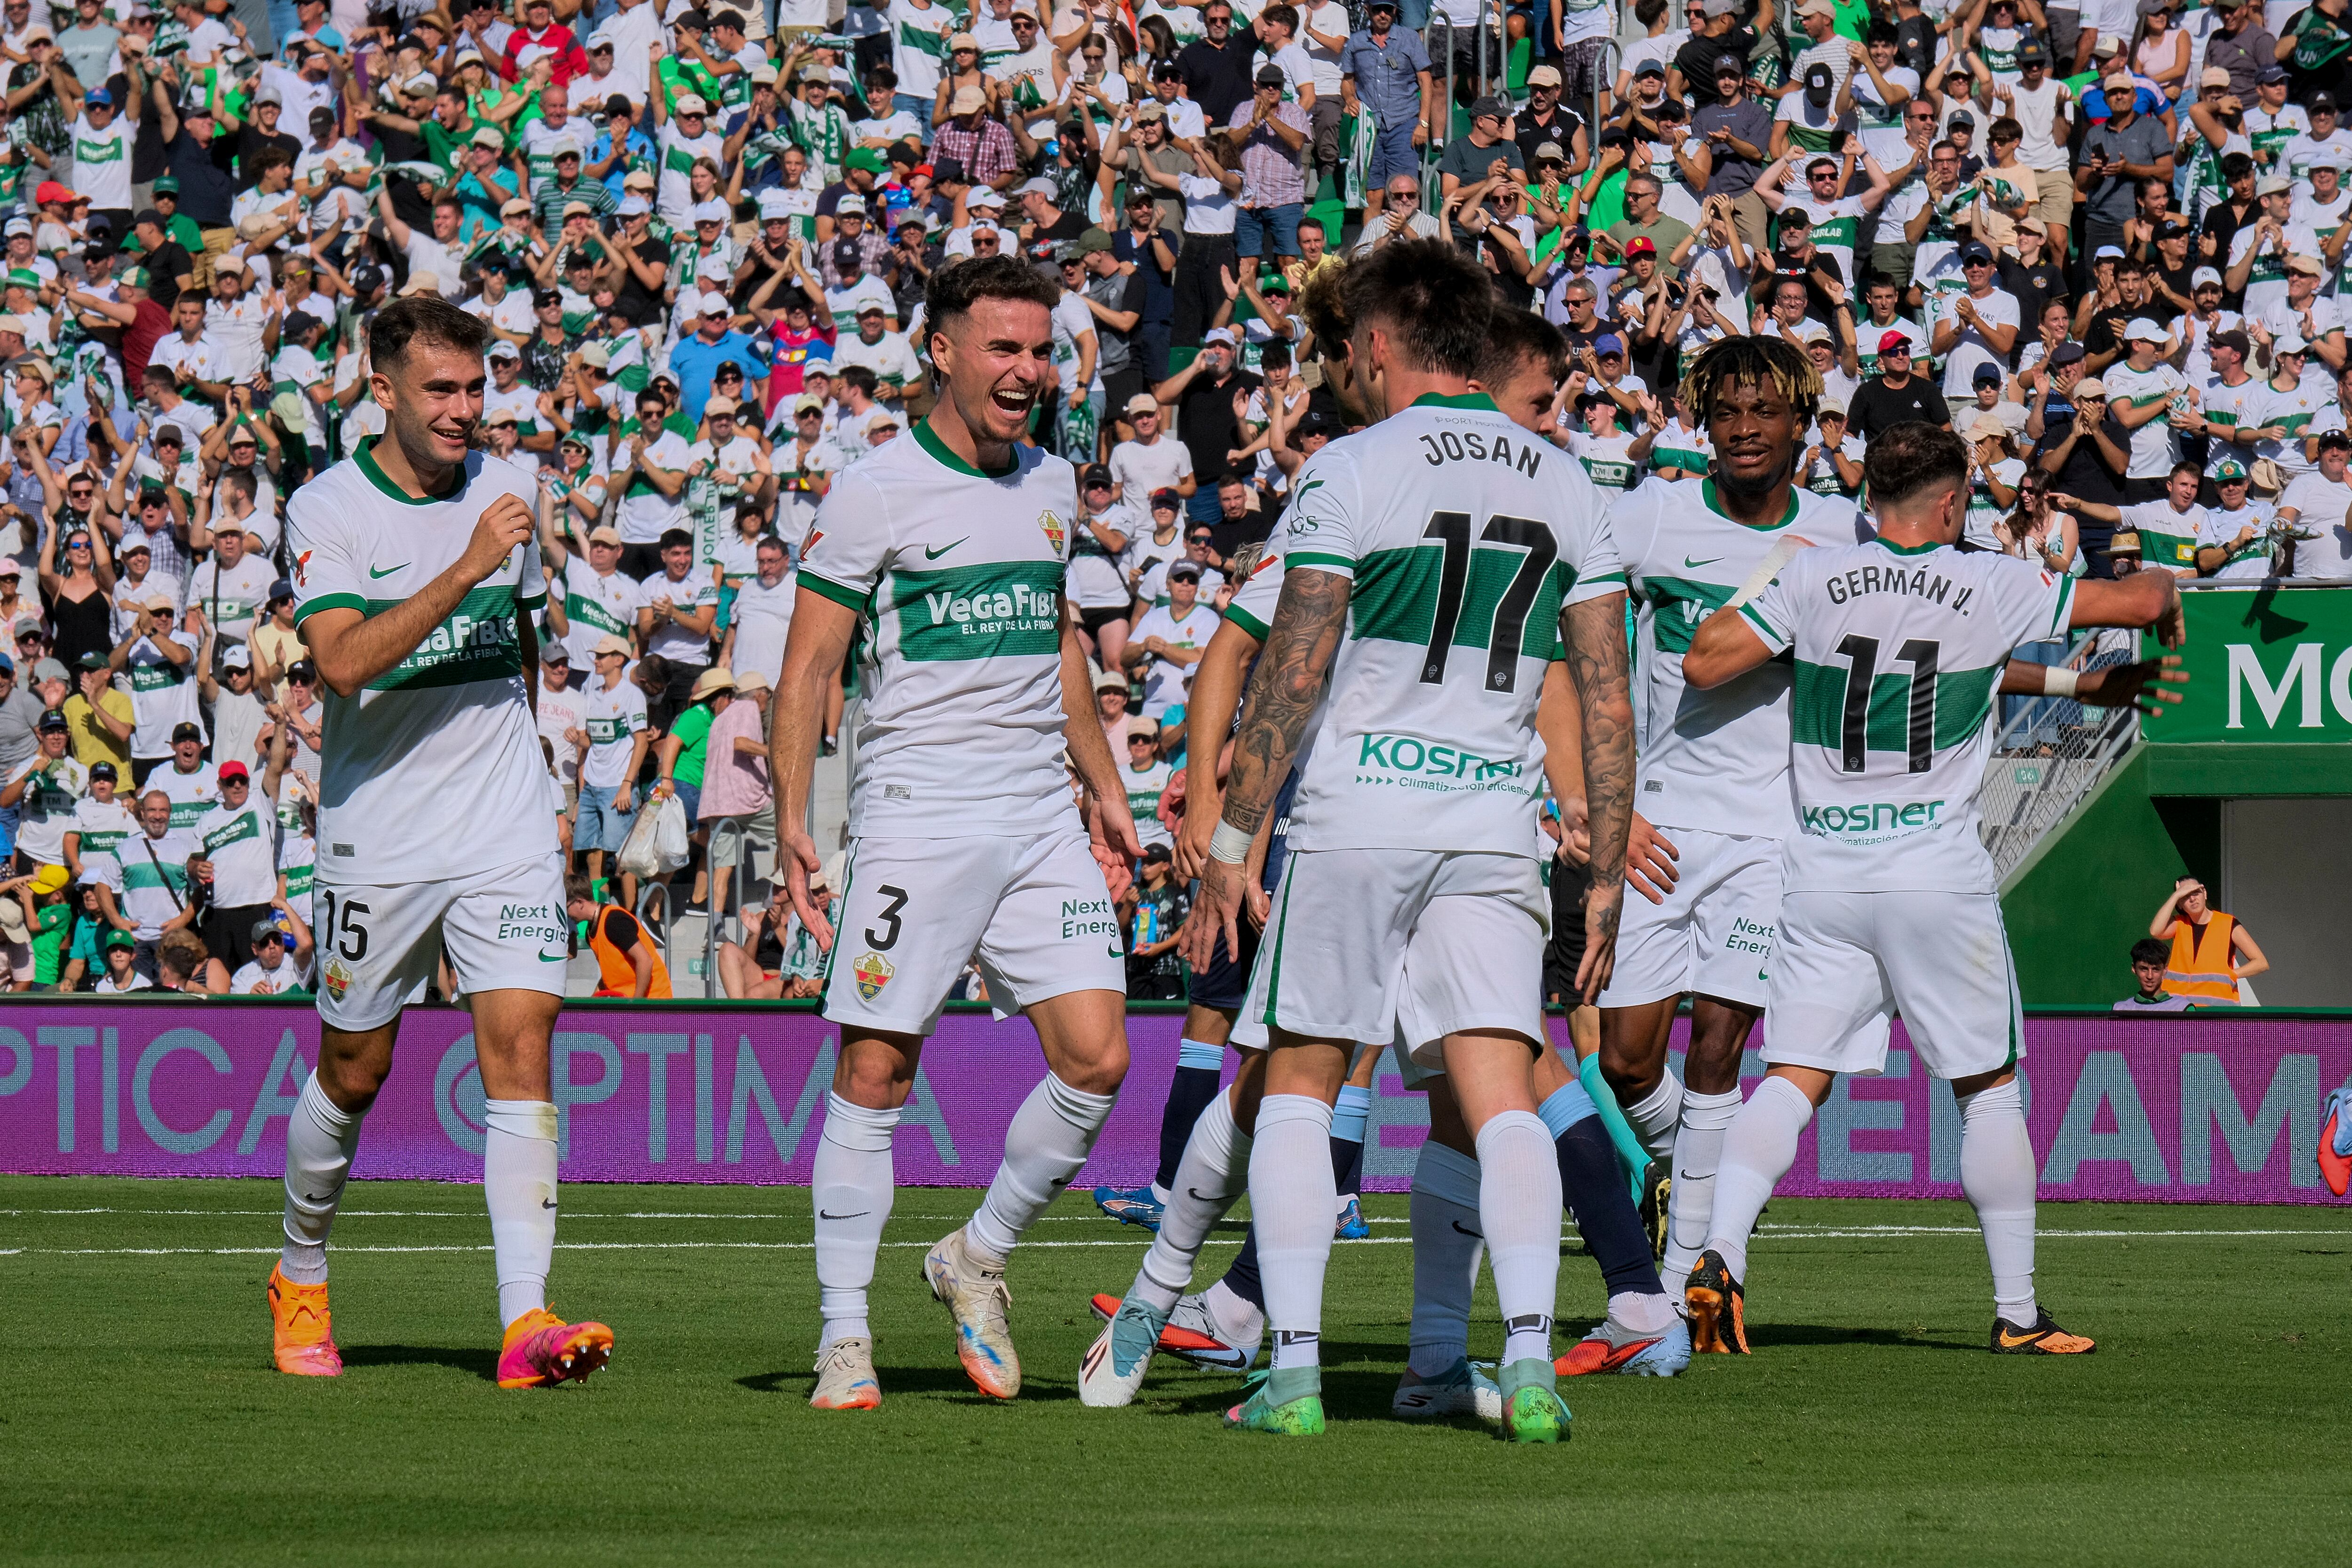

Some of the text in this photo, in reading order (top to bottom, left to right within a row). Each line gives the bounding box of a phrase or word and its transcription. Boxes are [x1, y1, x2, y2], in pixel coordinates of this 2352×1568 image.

[1418, 430, 1542, 480] JOSAN
[1419, 509, 1559, 695] 17
[1827, 564, 1952, 605] GERMÁN
[962, 619, 1055, 634] EL REY DE LA FIBRA
[417, 655, 439, 667] REY
[442, 653, 456, 664] DE
[458, 651, 472, 661] LA
[474, 648, 503, 659] FIBRA
[1834, 633, 1940, 774] 11
[2224, 643, 2352, 729] M
[323, 889, 371, 962] 15
[500, 904, 548, 919] Next
[864, 884, 909, 951] 3
[1062, 898, 1108, 918] Next
[1732, 917, 1775, 938] Next
[498, 922, 565, 944] Energía
